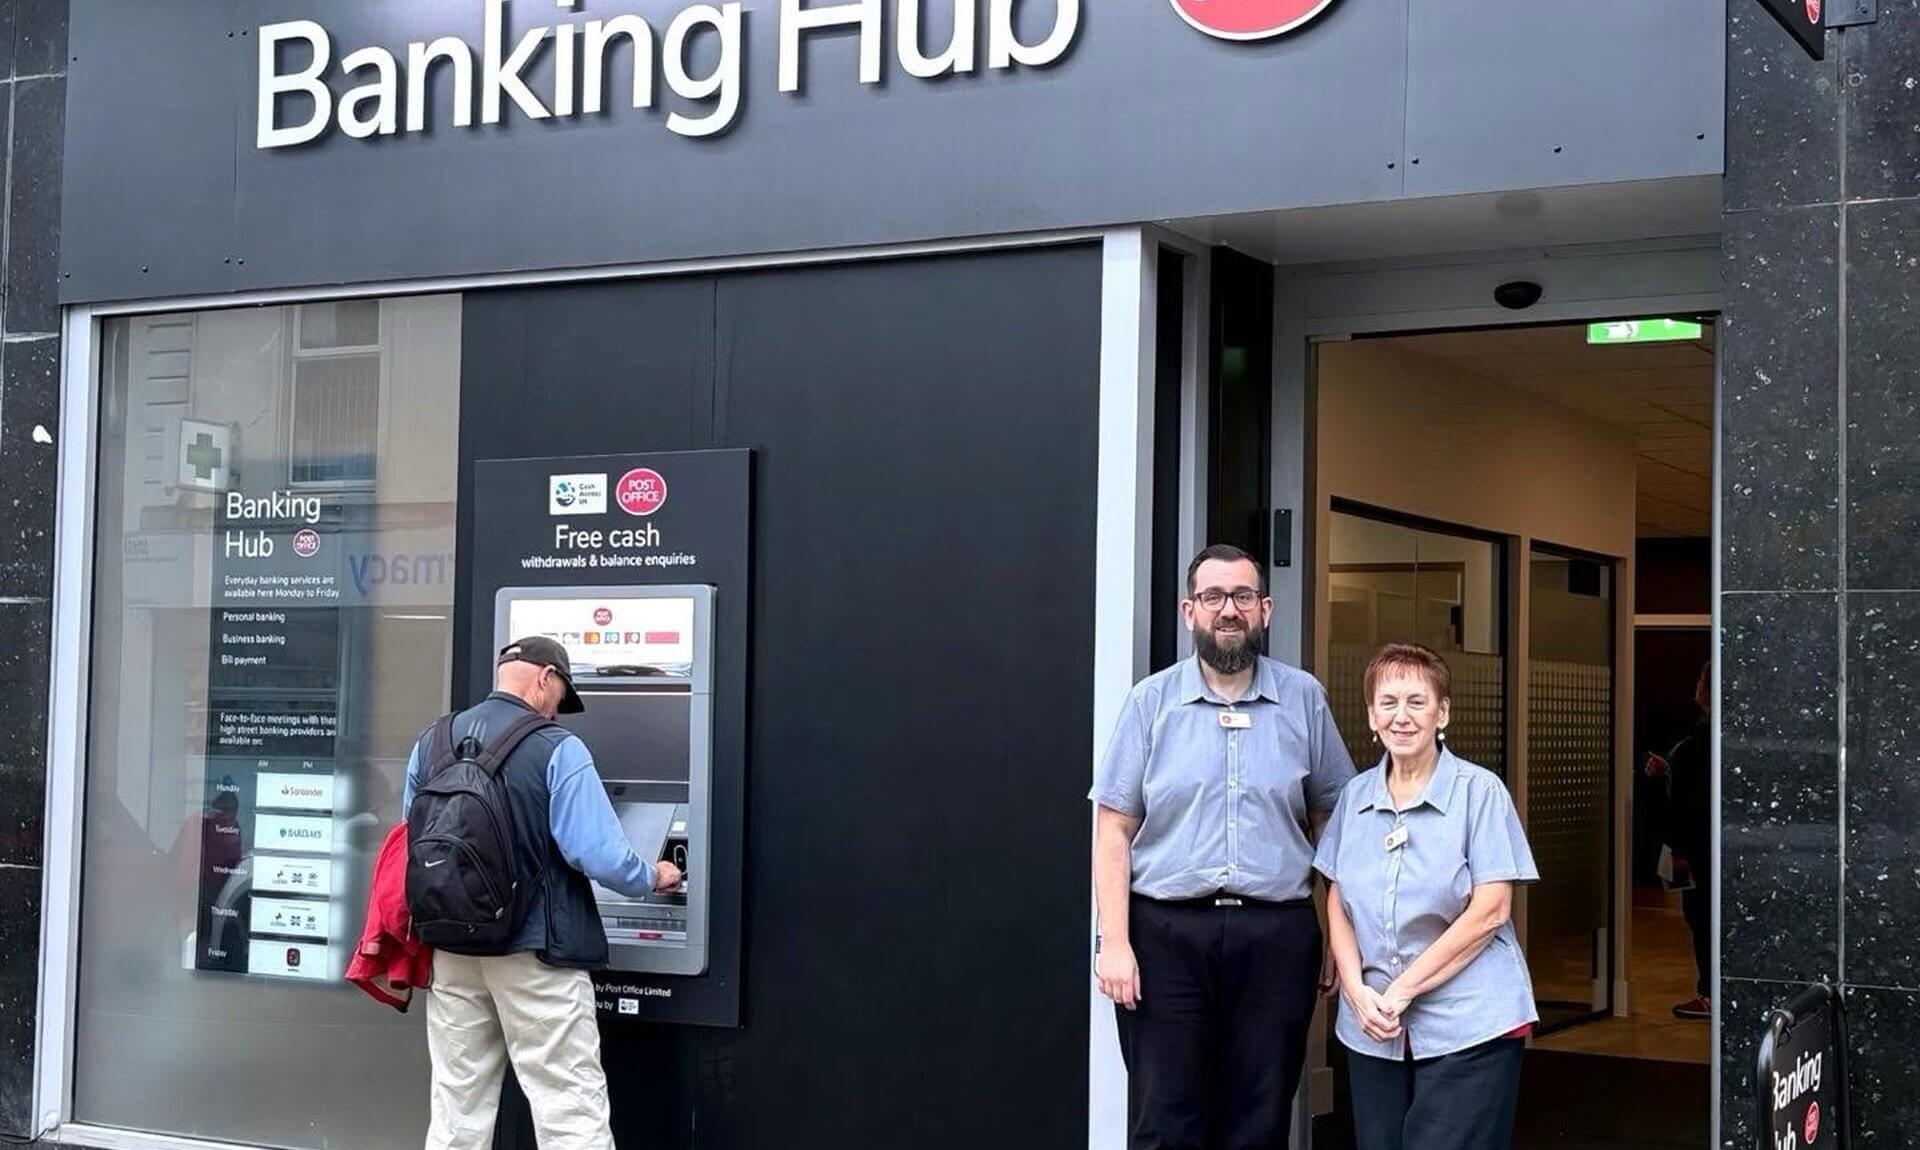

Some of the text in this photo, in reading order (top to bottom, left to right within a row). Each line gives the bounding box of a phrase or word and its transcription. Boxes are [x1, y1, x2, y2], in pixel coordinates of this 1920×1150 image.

[257, 0, 743, 149] Banking
[628, 479, 656, 491] POST
[622, 490, 660, 503] OFFICE
[226, 490, 321, 524] Banking
[555, 522, 661, 549] Free cash
[225, 530, 275, 558] Hub
[521, 551, 697, 569] withdrawals & balance enquiries
[224, 575, 258, 586] Everyday
[259, 575, 290, 587] banking
[290, 576, 320, 585] services
[223, 587, 339, 599] available here Monday to Friday
[222, 611, 286, 624] Personal banking
[222, 633, 287, 646] Business banking
[221, 654, 267, 666] Bill payment
[220, 711, 266, 723] Face-to-face
[267, 713, 301, 726] meetings
[302, 715, 320, 725] with
[237, 725, 259, 735] street
[259, 725, 290, 737] banking
[290, 726, 326, 737] providers
[289, 786, 323, 797] Santander
[288, 828, 323, 839] BARCLAYS
[595, 983, 672, 998] by Post Office Limited
[604, 1000, 614, 1011] by
[1772, 1050, 1822, 1113] Banking
